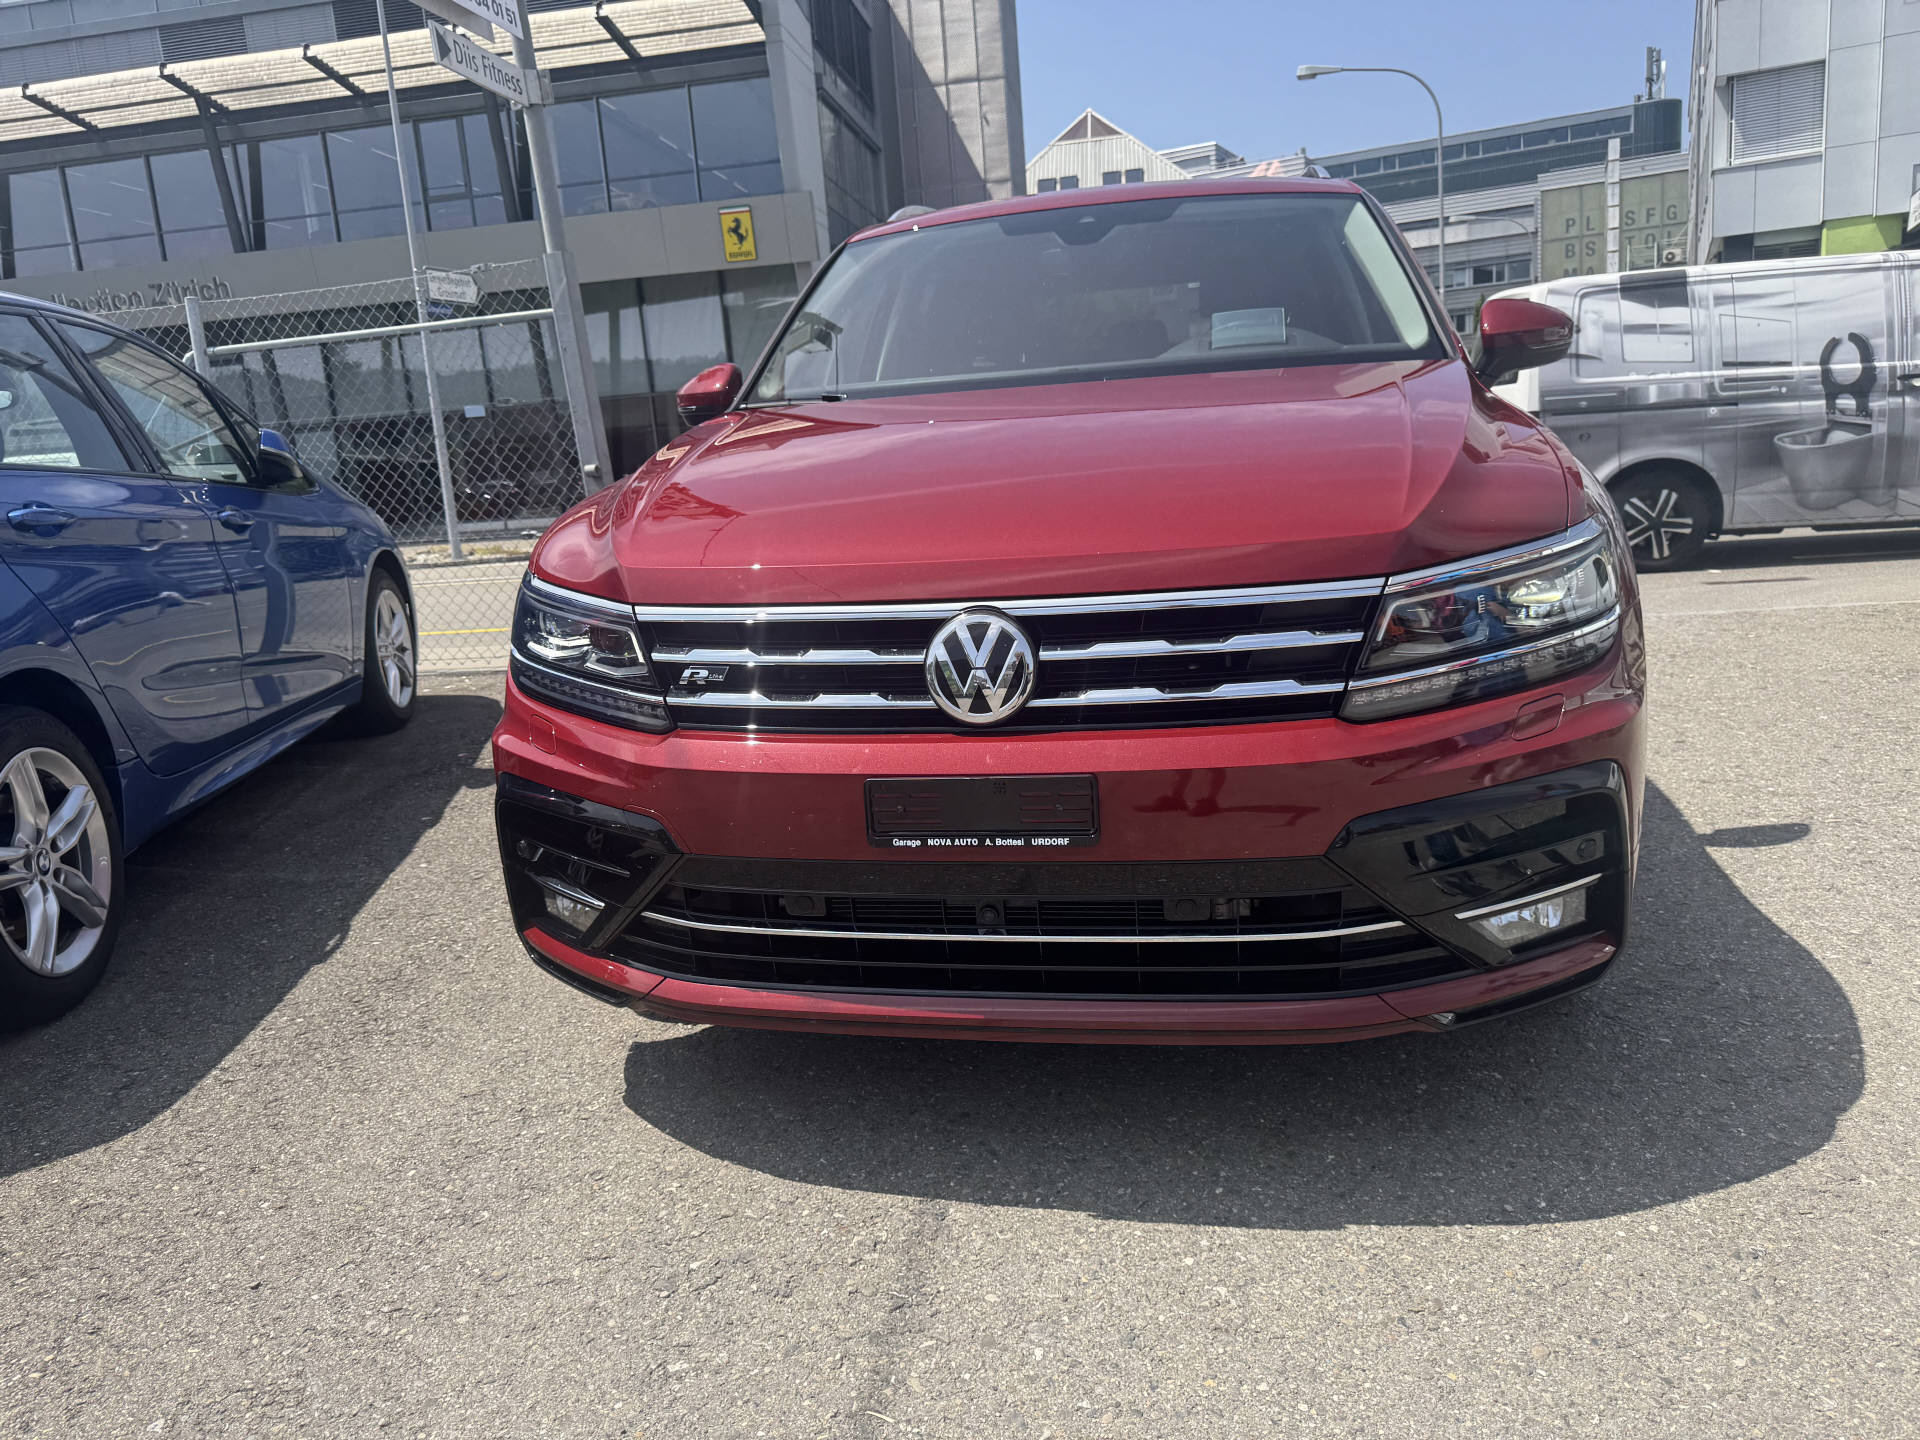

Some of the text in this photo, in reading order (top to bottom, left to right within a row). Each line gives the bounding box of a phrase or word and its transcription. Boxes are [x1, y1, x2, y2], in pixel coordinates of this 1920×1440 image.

[505, 7, 518, 28] 51
[453, 40, 523, 95] Diis Fitness
[148, 275, 232, 307] Zürich
[892, 838, 922, 848] Garage
[927, 838, 952, 846] NOVA
[954, 838, 979, 846] AUTO
[985, 838, 994, 846] A.
[1031, 837, 1070, 846] URDORF
